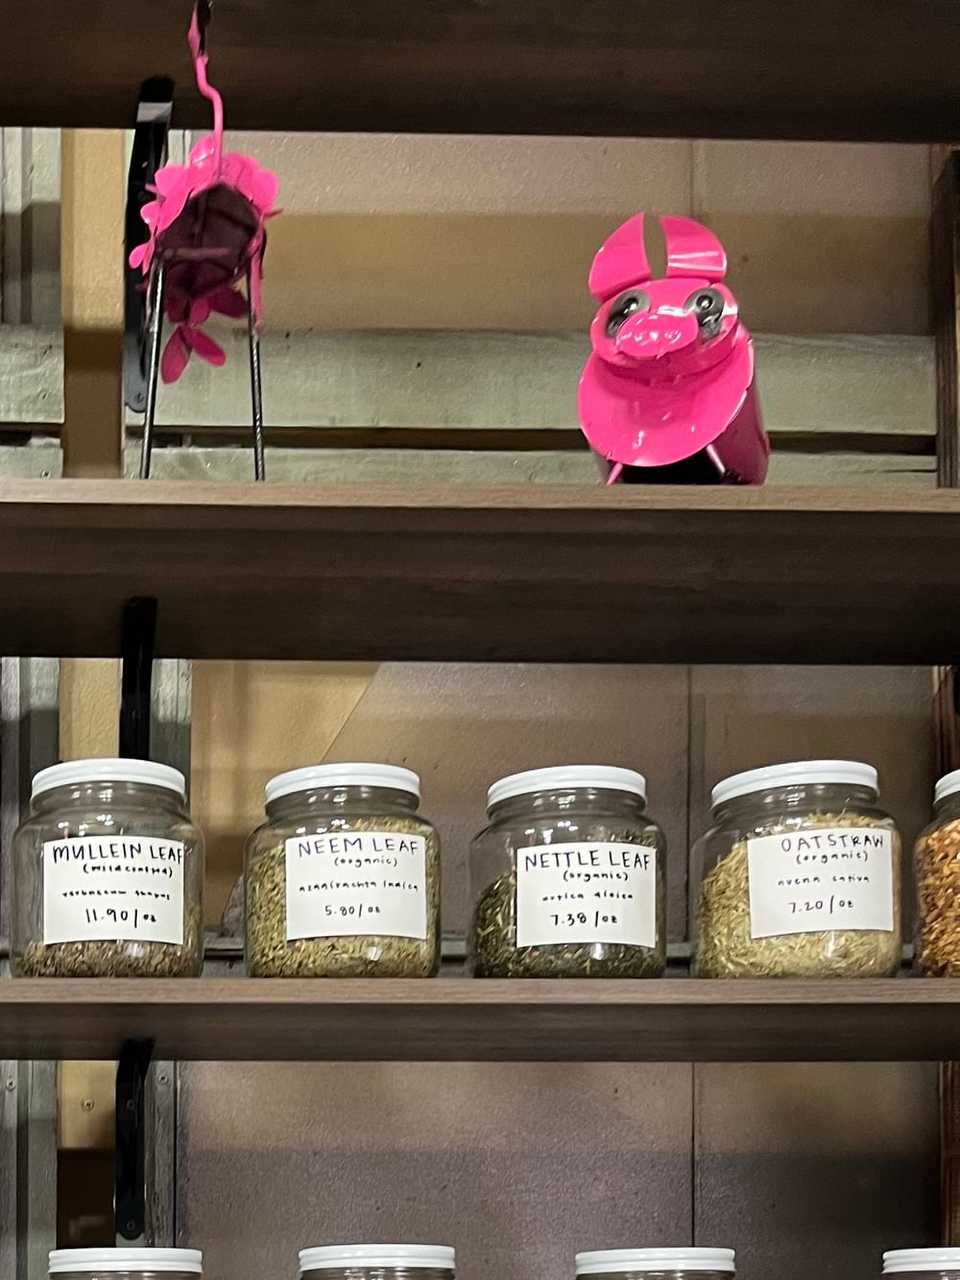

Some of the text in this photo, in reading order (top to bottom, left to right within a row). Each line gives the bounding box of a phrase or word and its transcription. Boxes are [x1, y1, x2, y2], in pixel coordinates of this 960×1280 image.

[52, 843, 182, 864] MULLEIN LEAF
[298, 837, 419, 857] NEEM LEAF
[334, 857, 397, 868] (organic)
[525, 850, 651, 872] NETTLE LEAF
[796, 850, 869, 865] (organic)
[563, 870, 629, 882] (organic)
